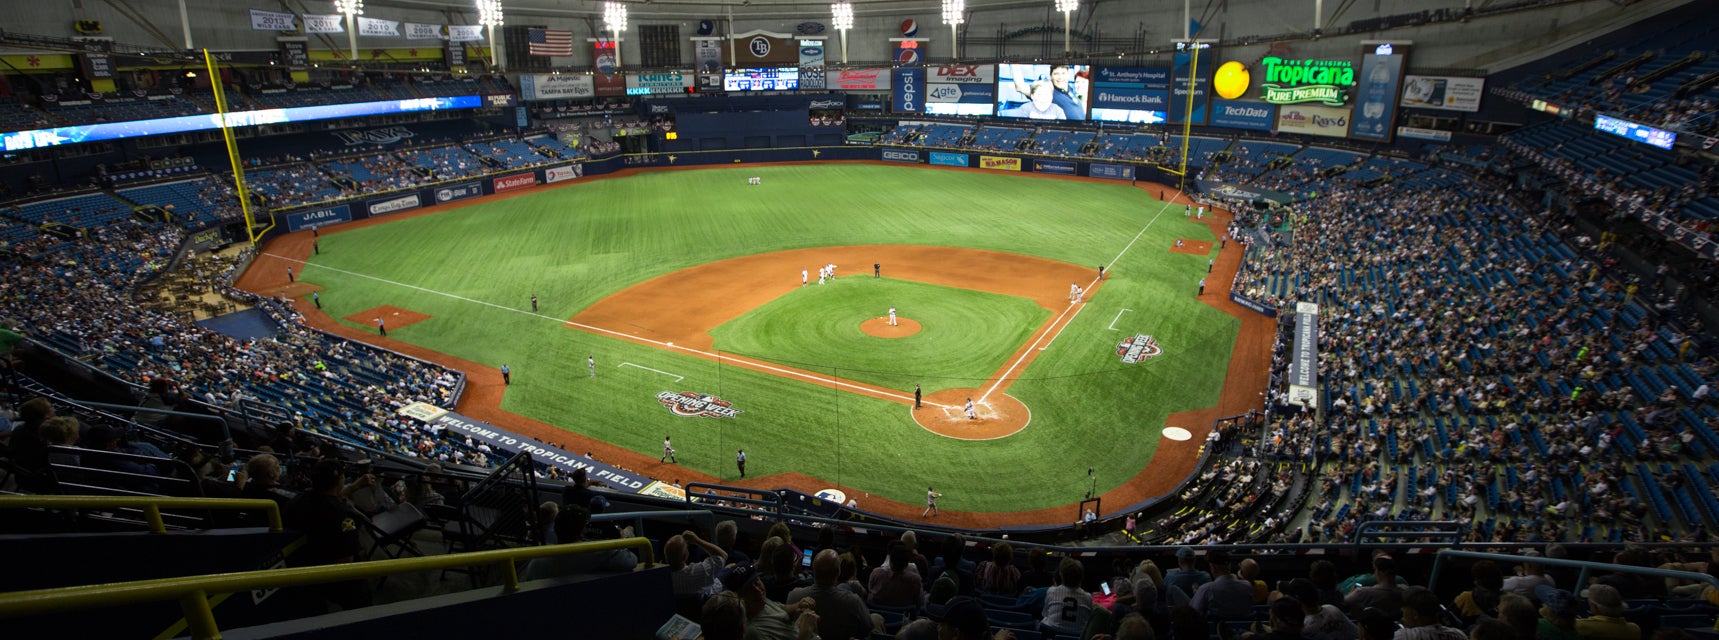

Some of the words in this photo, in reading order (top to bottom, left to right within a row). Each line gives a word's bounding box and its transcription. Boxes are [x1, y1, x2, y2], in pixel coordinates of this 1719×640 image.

[263, 17, 284, 25] 2013
[754, 40, 768, 54] TB
[937, 64, 980, 76] DEX
[1262, 56, 1354, 86] Tropicana
[902, 71, 915, 110] pepsi
[940, 88, 956, 96] gte
[1267, 88, 1292, 100] PURE
[1292, 88, 1338, 100] PREMIUM
[1108, 94, 1140, 102] Hancock
[1142, 94, 1162, 104] Bank
[1224, 106, 1245, 116] Tech
[1245, 108, 1268, 117] Data
[1337, 116, 1346, 126] 6
[884, 152, 918, 160] GEICO
[372, 204, 390, 214] Tampa
[391, 201, 401, 210] Bay
[402, 198, 417, 208] Times
[304, 210, 336, 220] JABIL
[1301, 326, 1312, 350] TROPICANA
[1298, 358, 1310, 386] WELCOME
[657, 391, 707, 408] OPENING
[705, 403, 739, 418] WEEK
[439, 416, 500, 439] WELCOME
[498, 436, 517, 446] TO
[518, 442, 595, 474] TROPICANA
[596, 469, 643, 489] FIELD
[1062, 596, 1078, 622] 2
